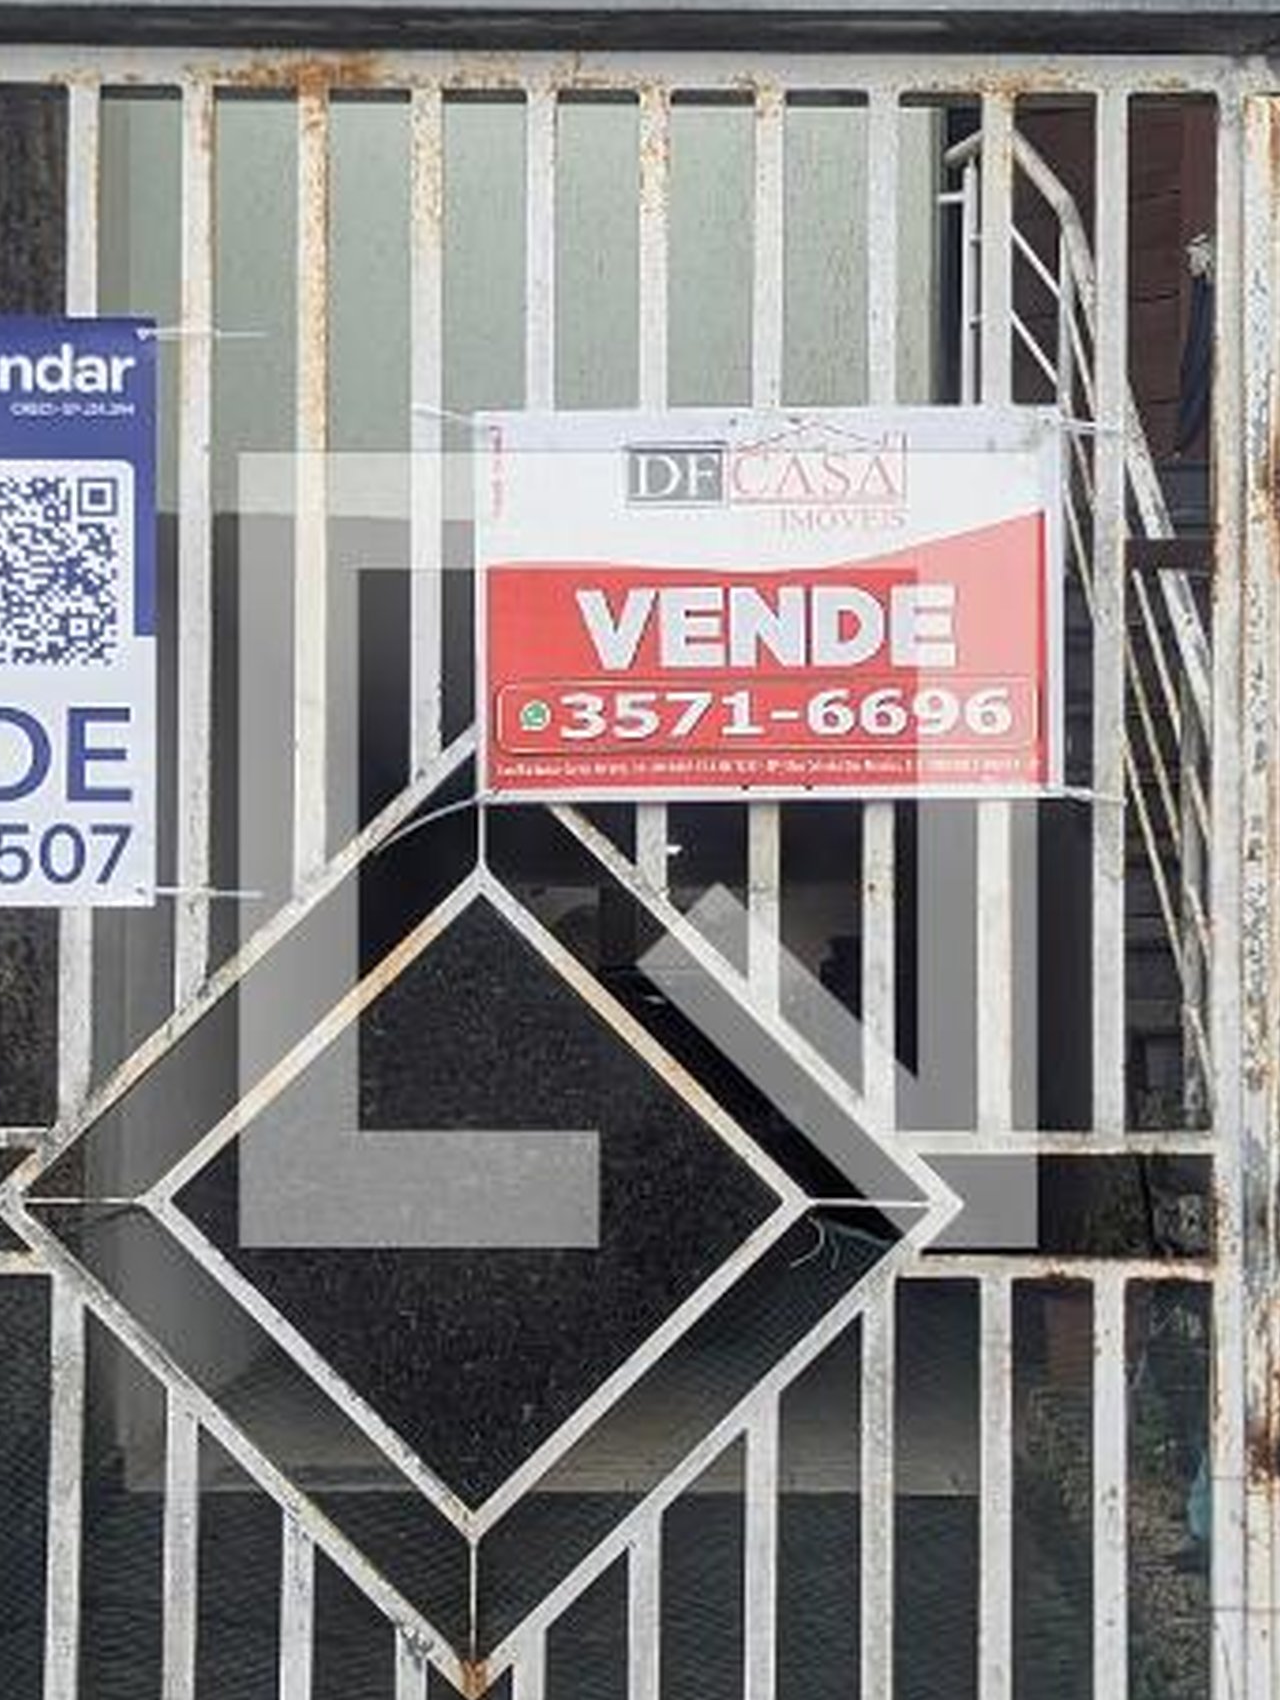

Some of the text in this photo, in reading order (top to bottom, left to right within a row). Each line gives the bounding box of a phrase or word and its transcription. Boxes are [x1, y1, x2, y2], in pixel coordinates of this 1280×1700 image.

[731, 451, 899, 497] CASA
[575, 584, 957, 671] VENDE
[559, 687, 1014, 740] 3571-6696
